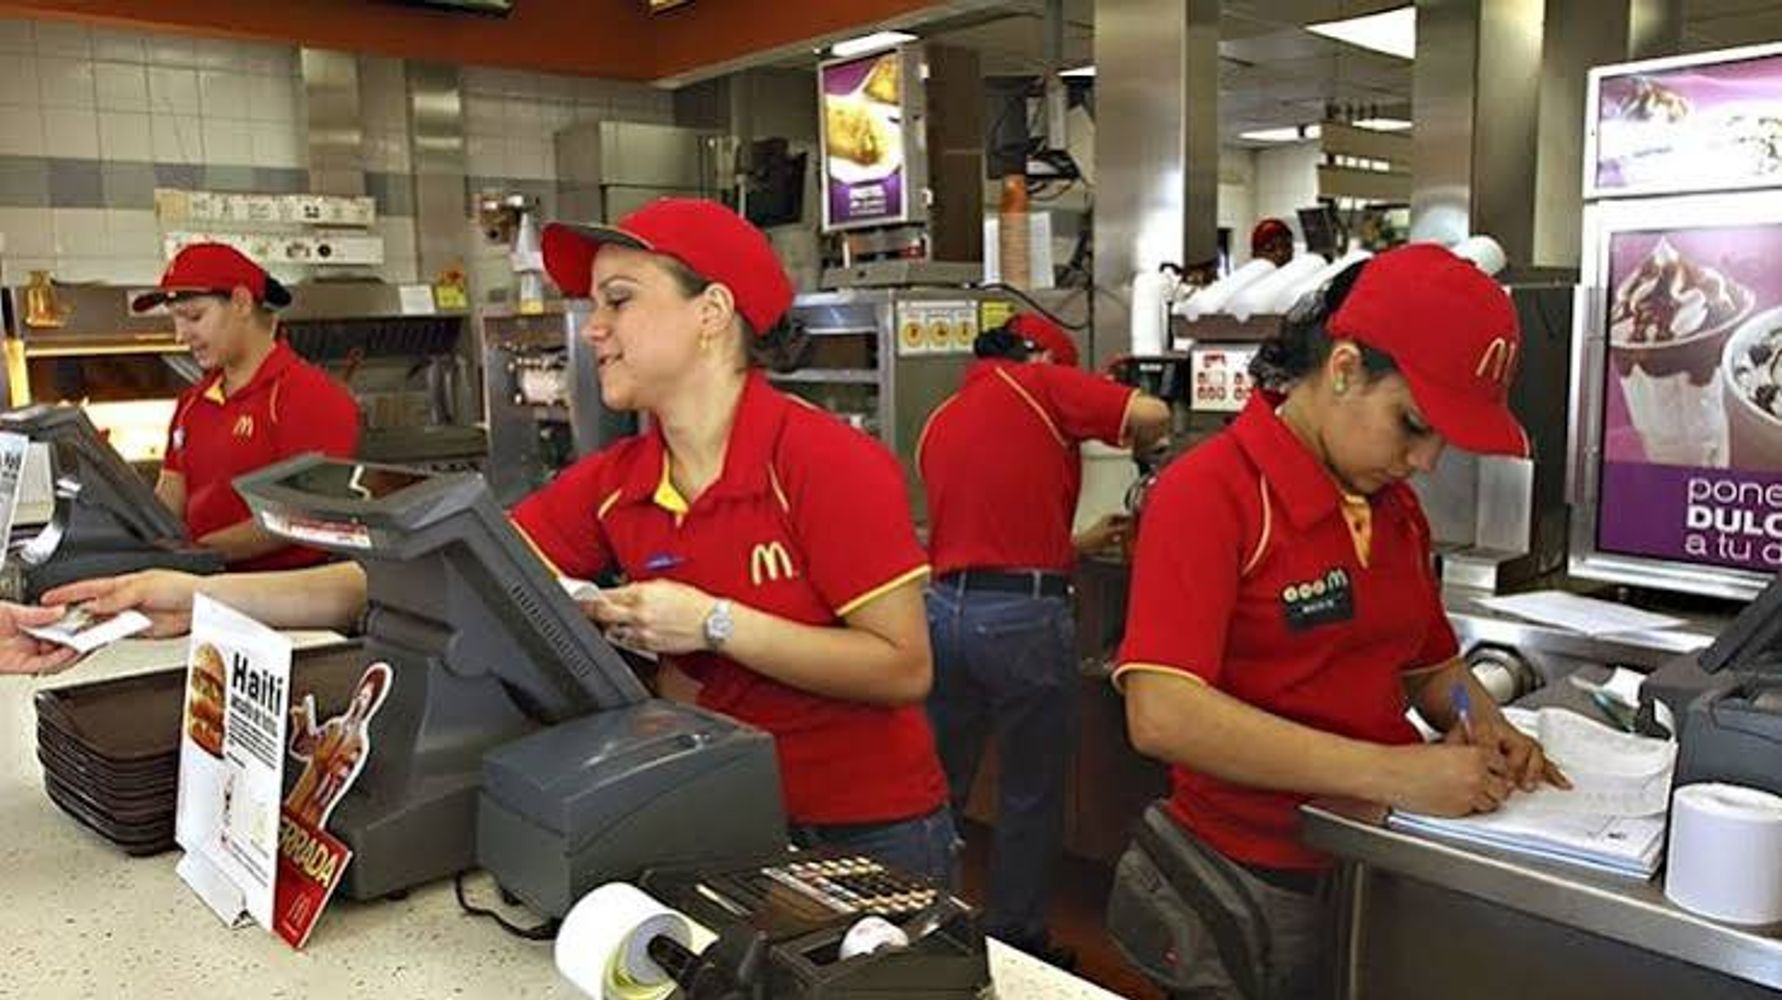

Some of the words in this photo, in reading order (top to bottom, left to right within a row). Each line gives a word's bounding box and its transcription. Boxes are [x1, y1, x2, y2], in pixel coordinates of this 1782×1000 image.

[751, 541, 793, 586] M
[1685, 534, 1707, 555] a
[1719, 533, 1751, 560] tu
[232, 652, 283, 717] Haiti
